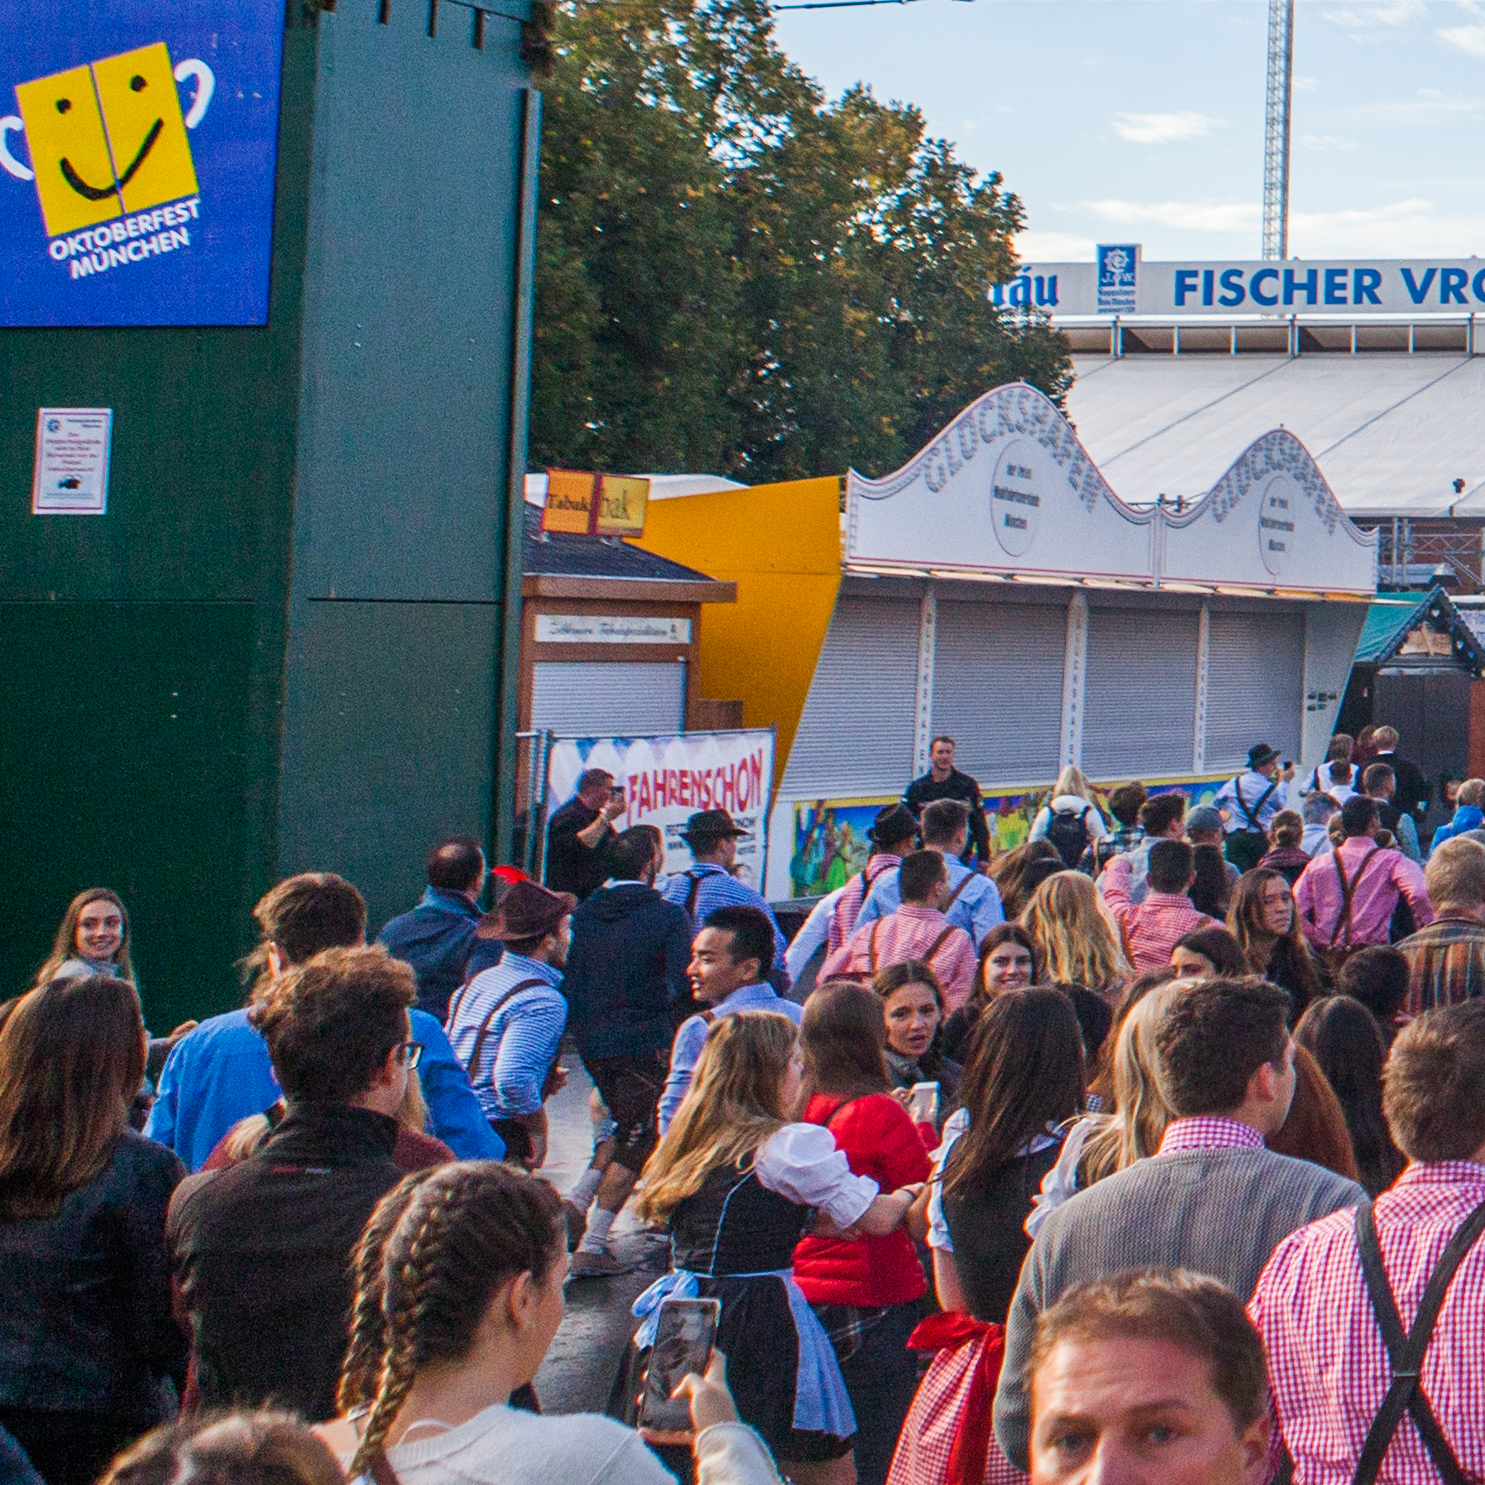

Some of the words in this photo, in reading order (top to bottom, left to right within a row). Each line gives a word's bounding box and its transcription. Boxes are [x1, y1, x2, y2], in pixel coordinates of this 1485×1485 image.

[49, 199, 201, 263] OKTOBERFEST
[69, 227, 191, 281] MÜNCHEN
[1175, 268, 1382, 307] FISCHER
[627, 748, 764, 827] FAHRENSCHON
